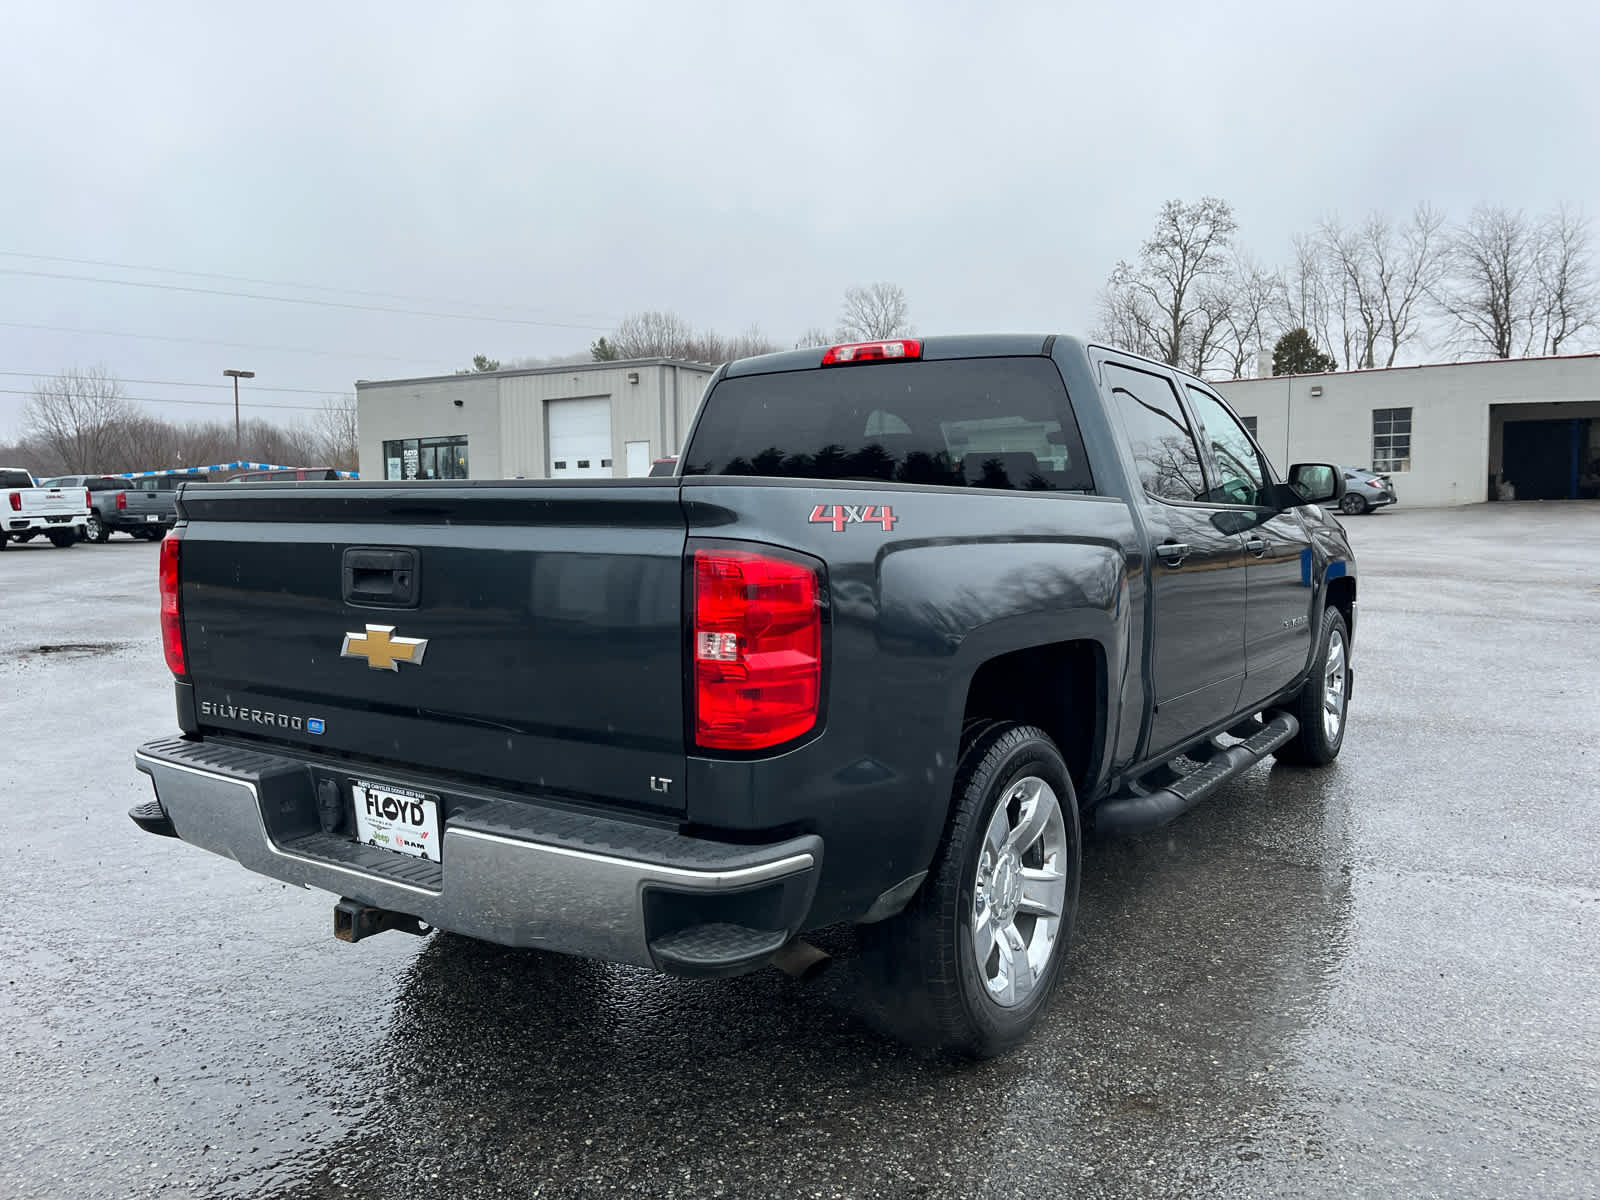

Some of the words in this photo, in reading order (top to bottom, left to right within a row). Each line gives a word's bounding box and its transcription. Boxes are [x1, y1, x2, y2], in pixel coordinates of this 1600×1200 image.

[201, 701, 301, 729] SILVERADO
[650, 776, 672, 792] LT
[365, 791, 424, 826] FLOYD
[404, 840, 425, 849] RAM
